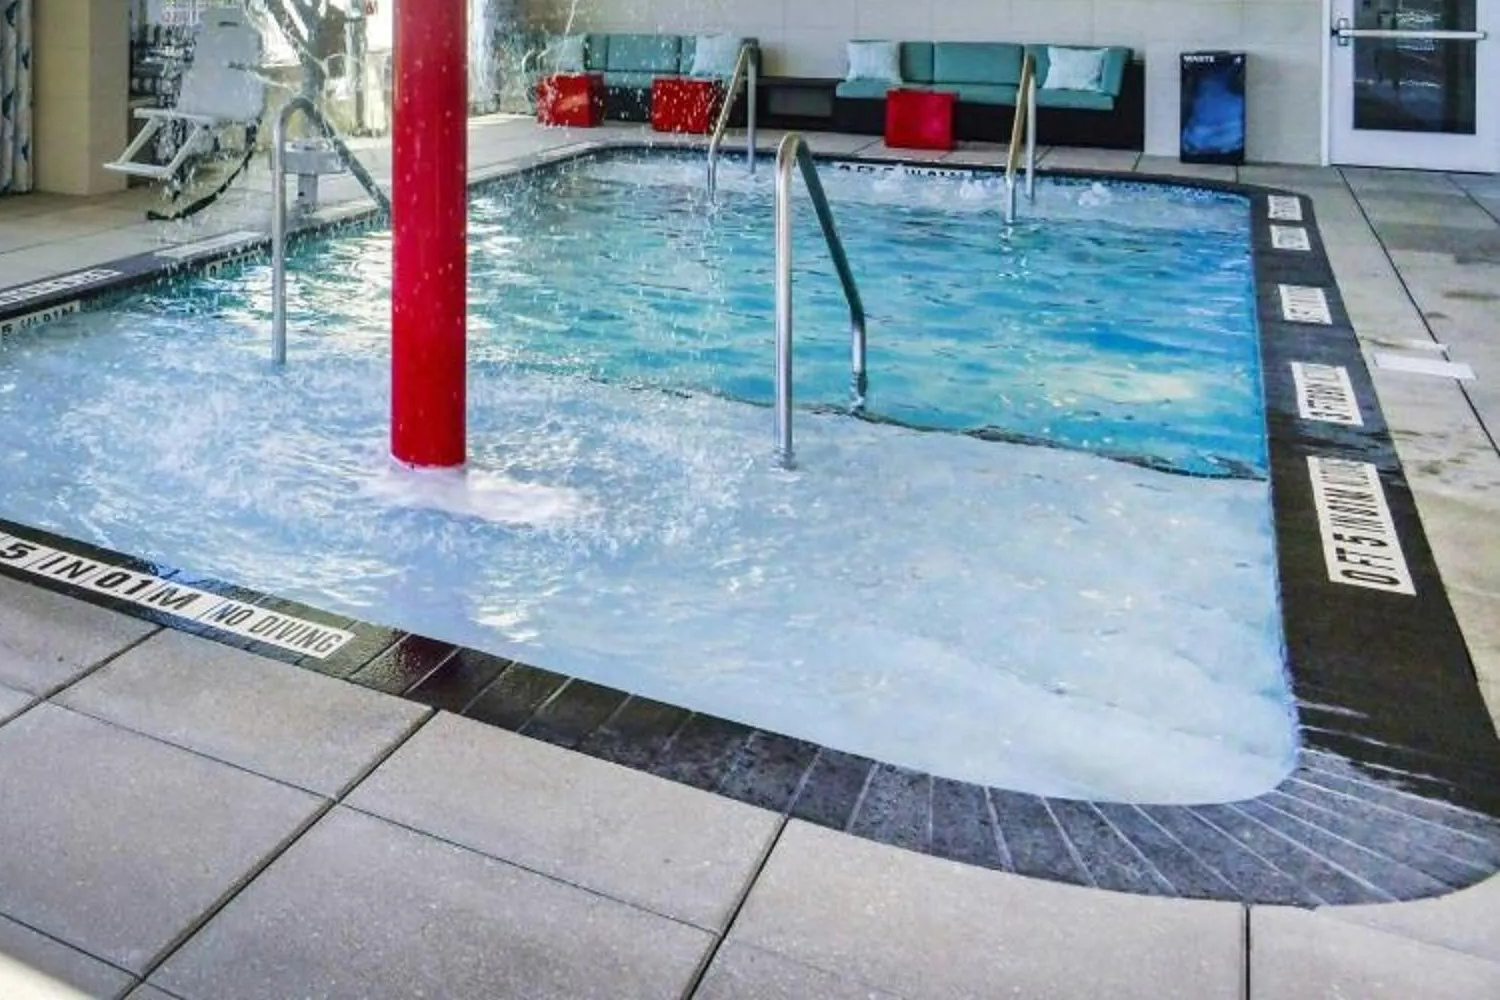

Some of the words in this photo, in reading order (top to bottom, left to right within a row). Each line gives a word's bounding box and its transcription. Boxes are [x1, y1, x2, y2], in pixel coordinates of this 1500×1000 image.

[1332, 532, 1388, 547] 5
[1335, 547, 1396, 571] FT
[38, 556, 97, 579] IN
[208, 603, 255, 626] NO
[249, 615, 343, 653] DIVING
